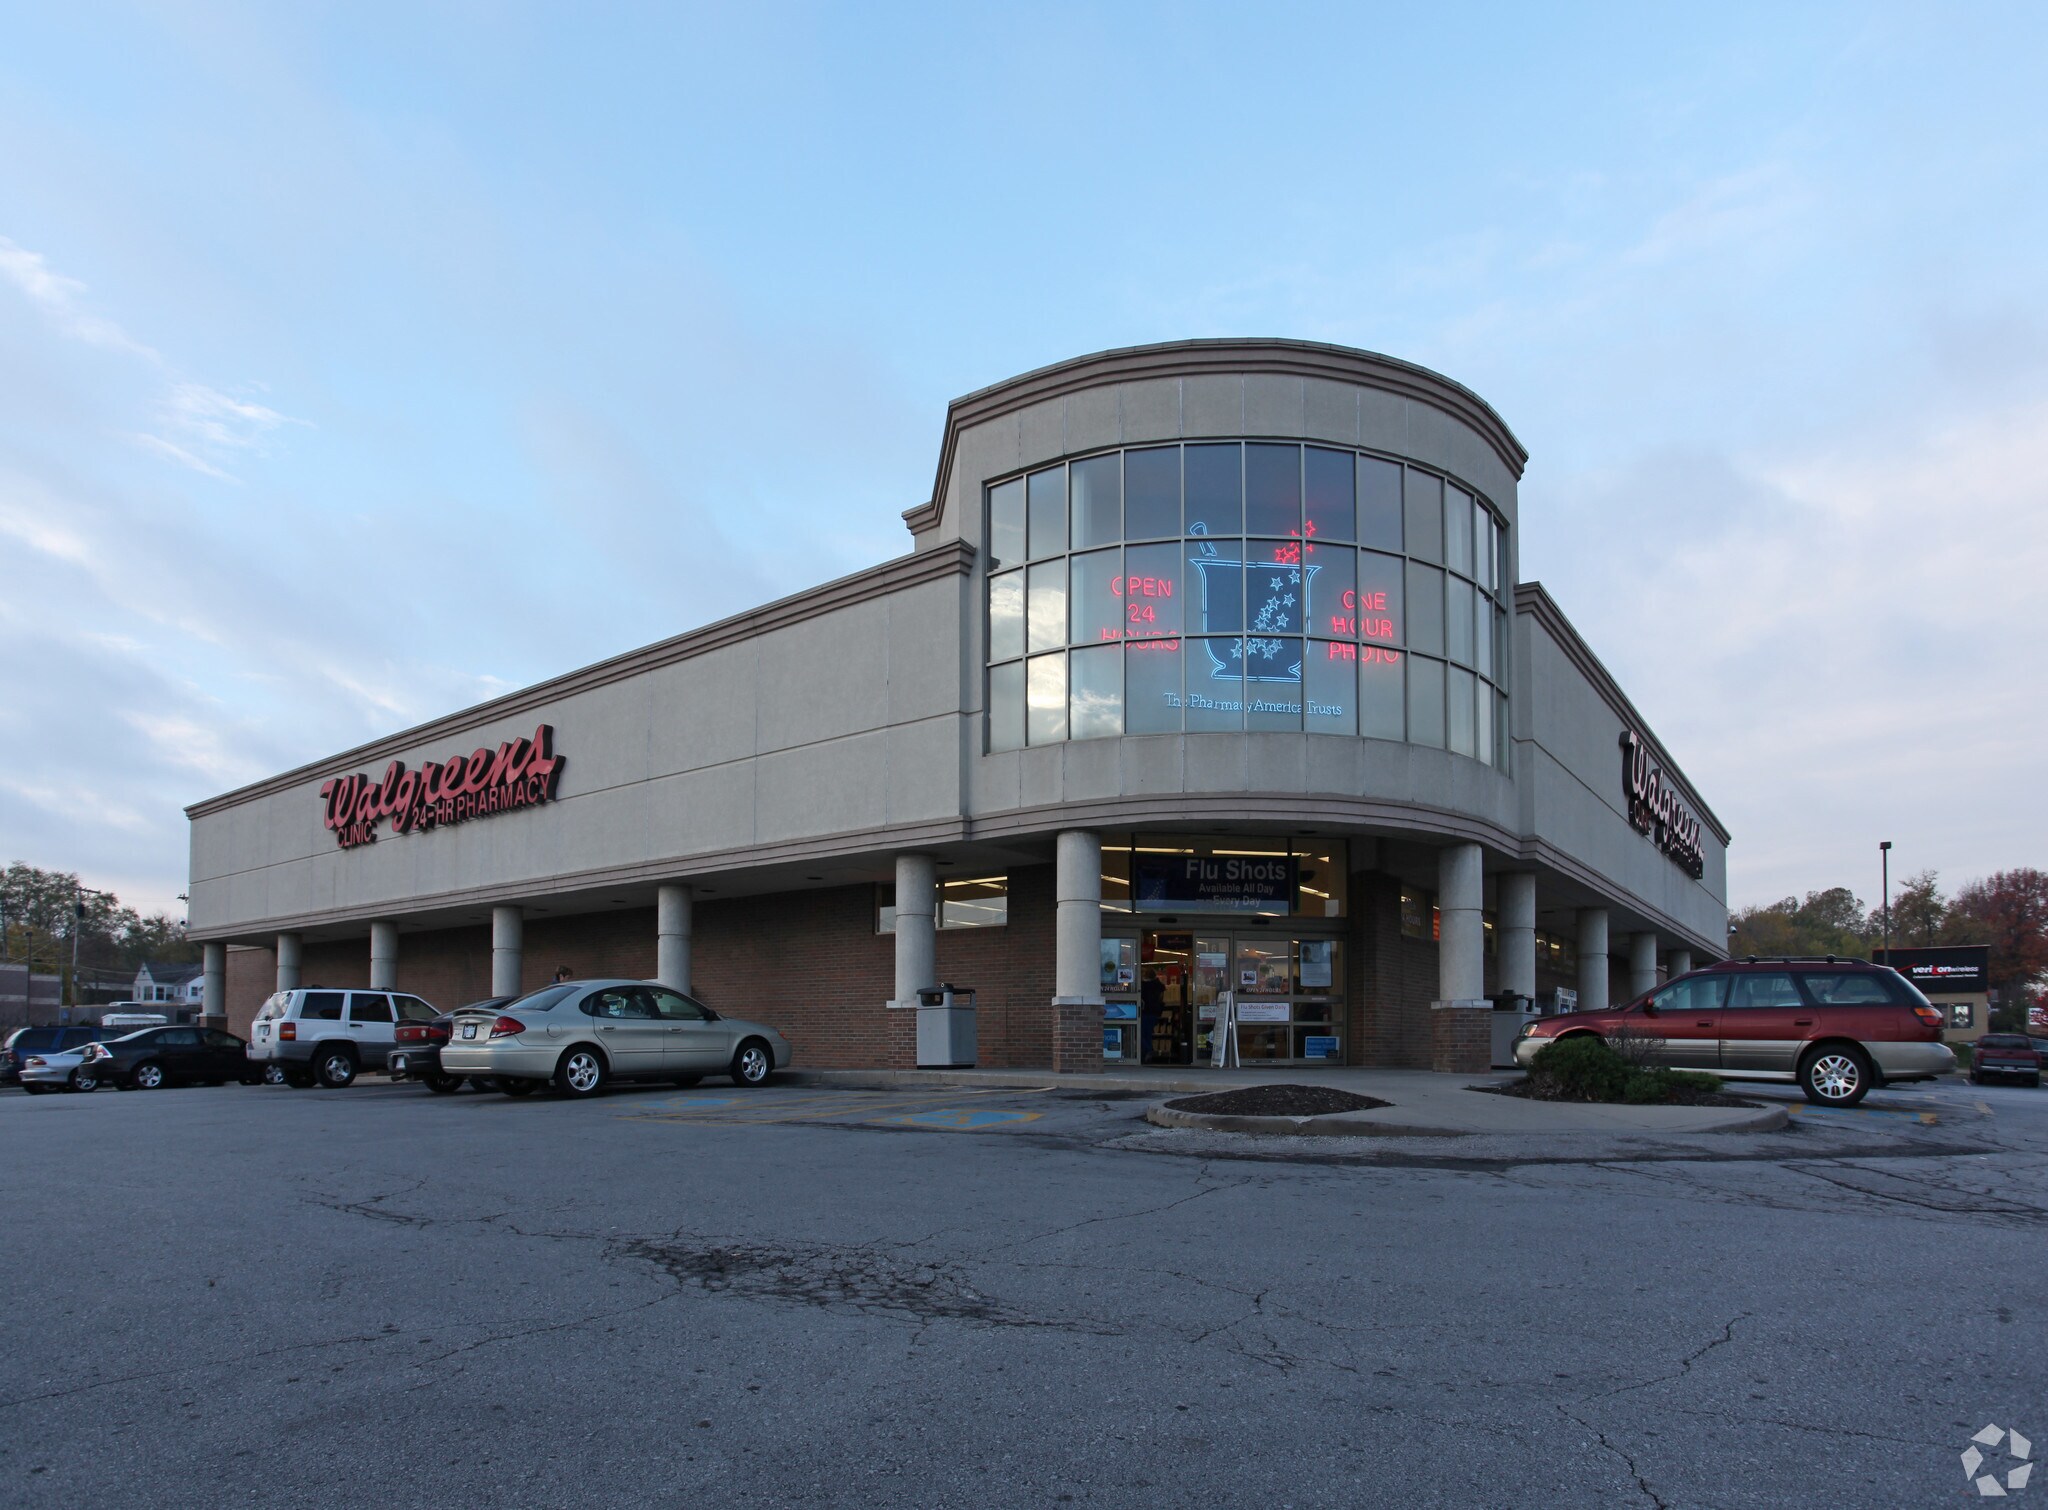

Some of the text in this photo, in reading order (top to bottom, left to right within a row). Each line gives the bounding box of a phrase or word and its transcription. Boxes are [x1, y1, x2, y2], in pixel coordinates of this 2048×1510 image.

[1111, 576, 1172, 597] OPEN
[1342, 589, 1386, 610] ONE
[1127, 603, 1155, 622] 24
[1331, 616, 1392, 638] HOUR
[1306, 700, 1342, 716] Trusts
[320, 723, 564, 834] Walgreens
[411, 772, 557, 830] 24-HR PHARMACY
[1621, 730, 1705, 862] Walgreens
[337, 820, 374, 849] CLINIC
[1186, 858, 1287, 881] Flu Shots
[1198, 883, 1275, 895] Available All Day
[1213, 895, 1261, 907] Every Day
